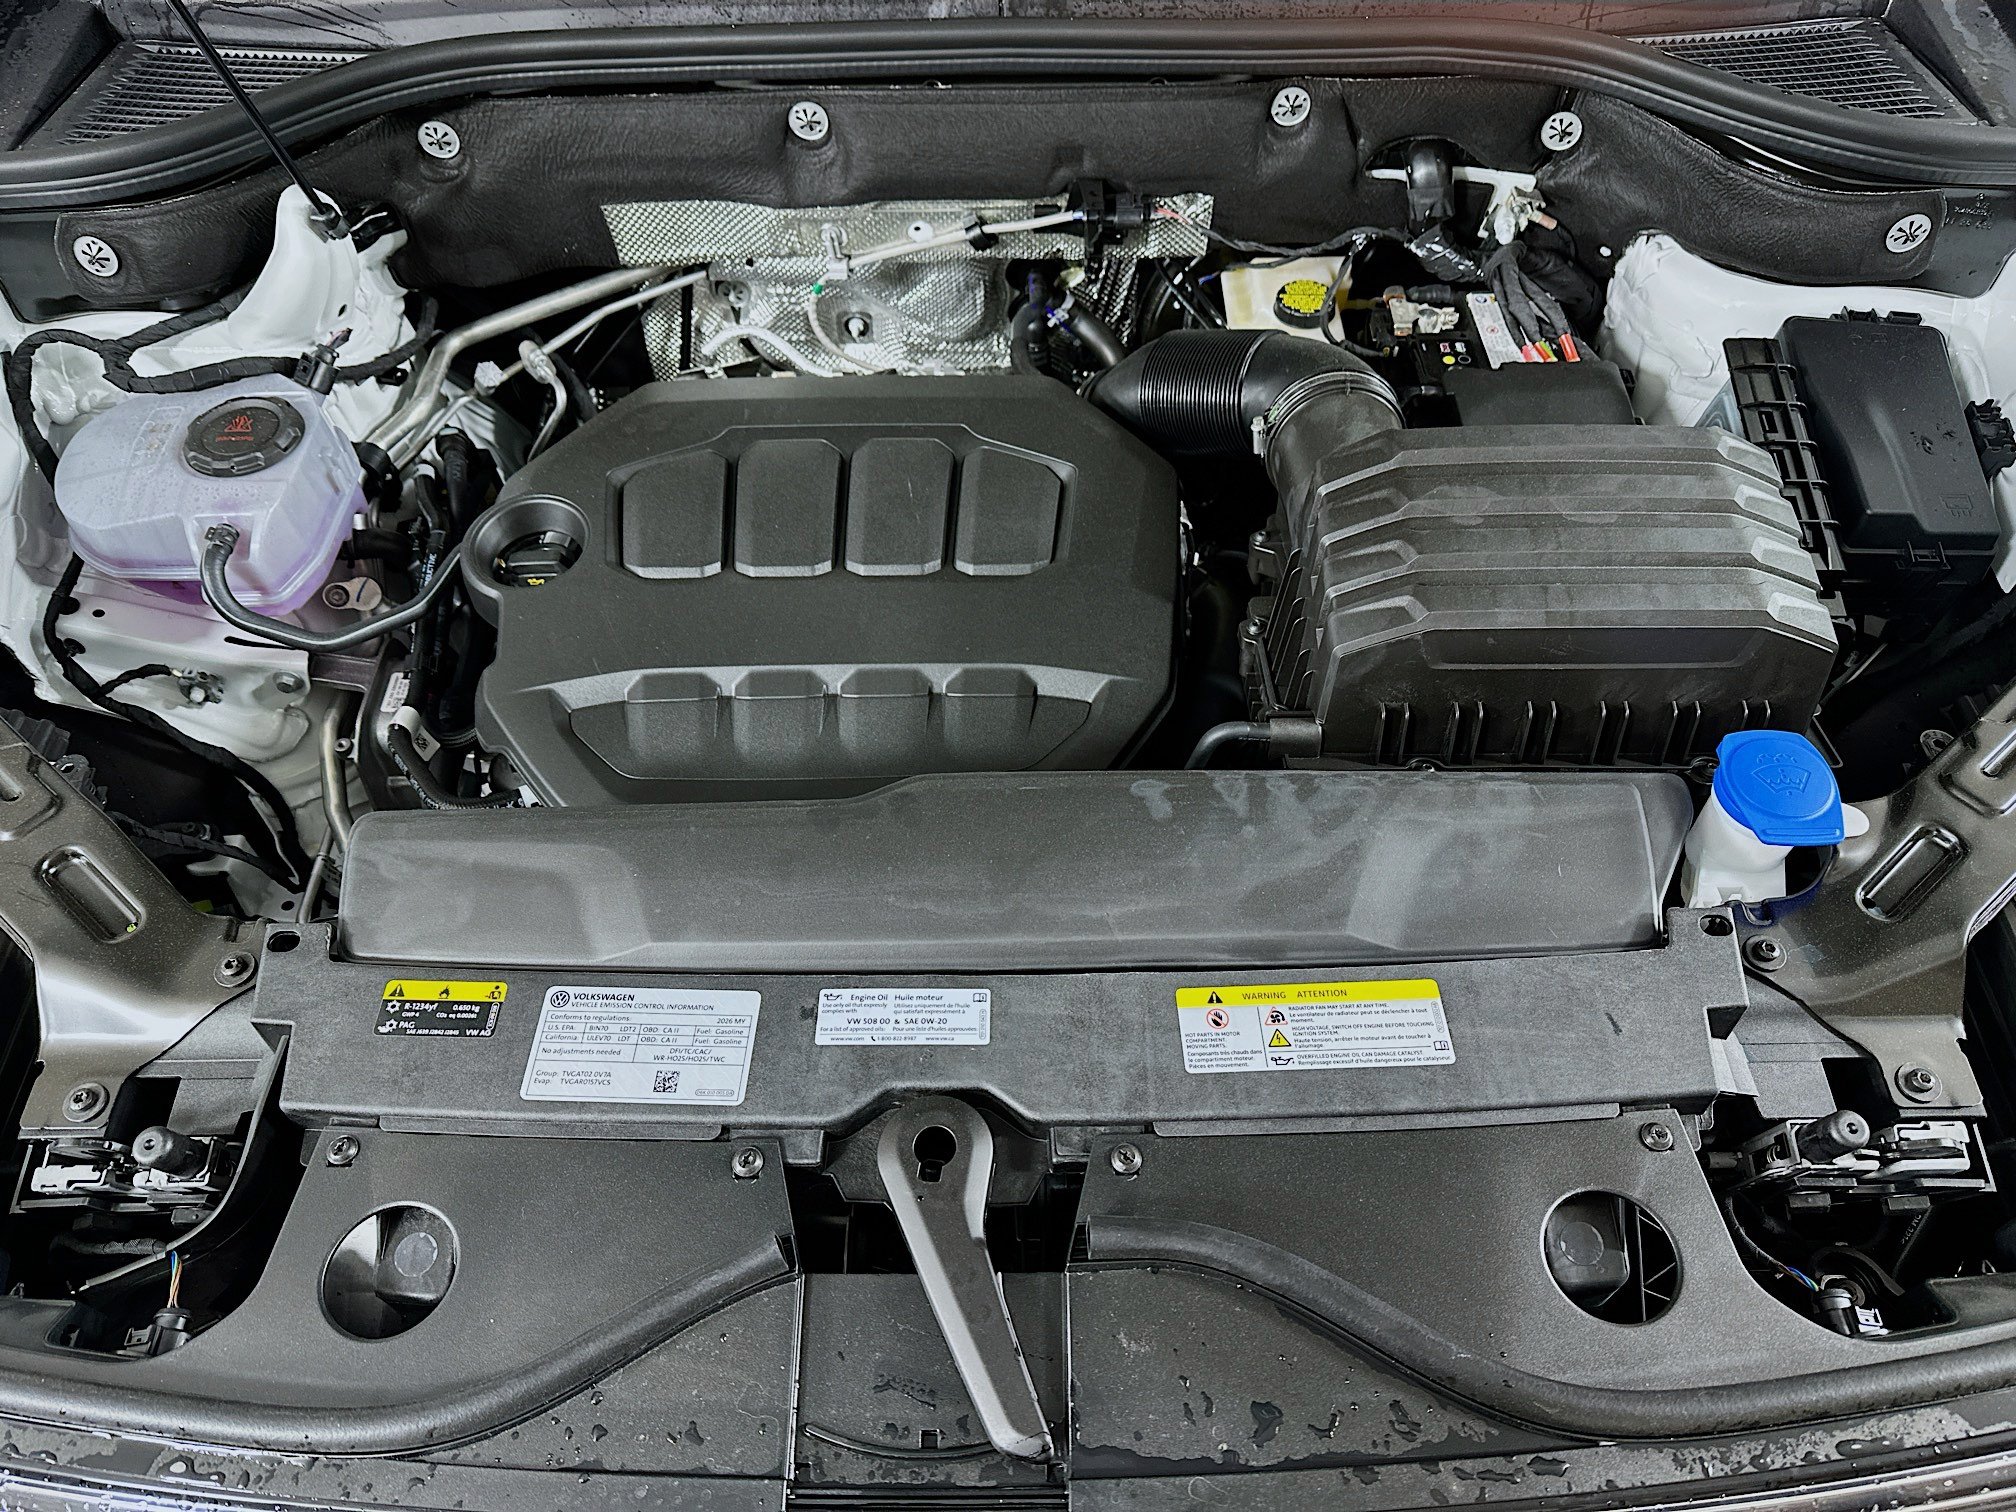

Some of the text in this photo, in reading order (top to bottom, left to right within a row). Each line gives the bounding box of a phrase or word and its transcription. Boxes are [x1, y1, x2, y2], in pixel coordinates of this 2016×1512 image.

[574, 992, 635, 1001] VOLKSWAGEN
[850, 994, 876, 1002] Engine
[1242, 989, 1348, 1000] WARNING ATTENTION
[404, 1002, 438, 1012] R-1234yf
[472, 1004, 480, 1012] kg
